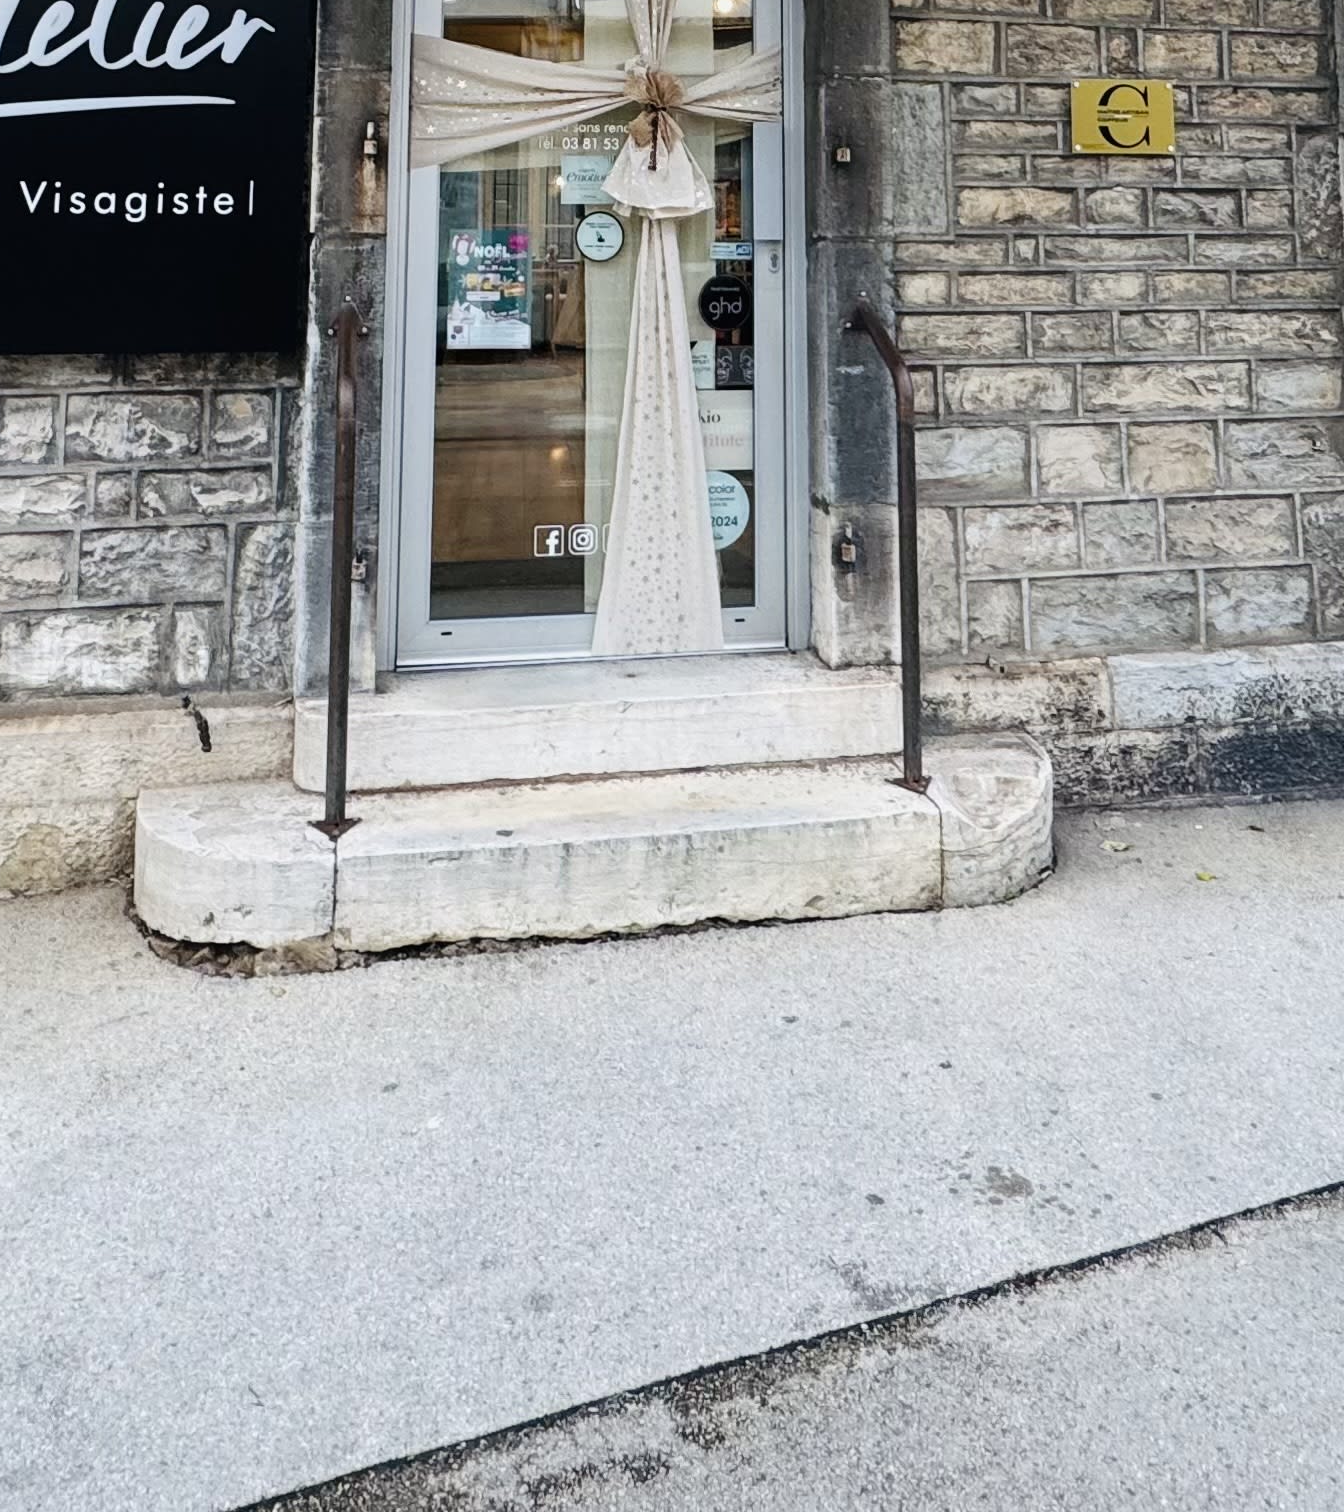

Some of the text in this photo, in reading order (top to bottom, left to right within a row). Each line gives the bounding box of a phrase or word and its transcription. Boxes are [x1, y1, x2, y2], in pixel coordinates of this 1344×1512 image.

[562, 137, 579, 150] 03
[582, 137, 597, 150] 81
[603, 137, 619, 150] 53
[19, 180, 235, 223] Visagiste
[709, 296, 743, 320] ghd
[711, 515, 738, 527] 2024
